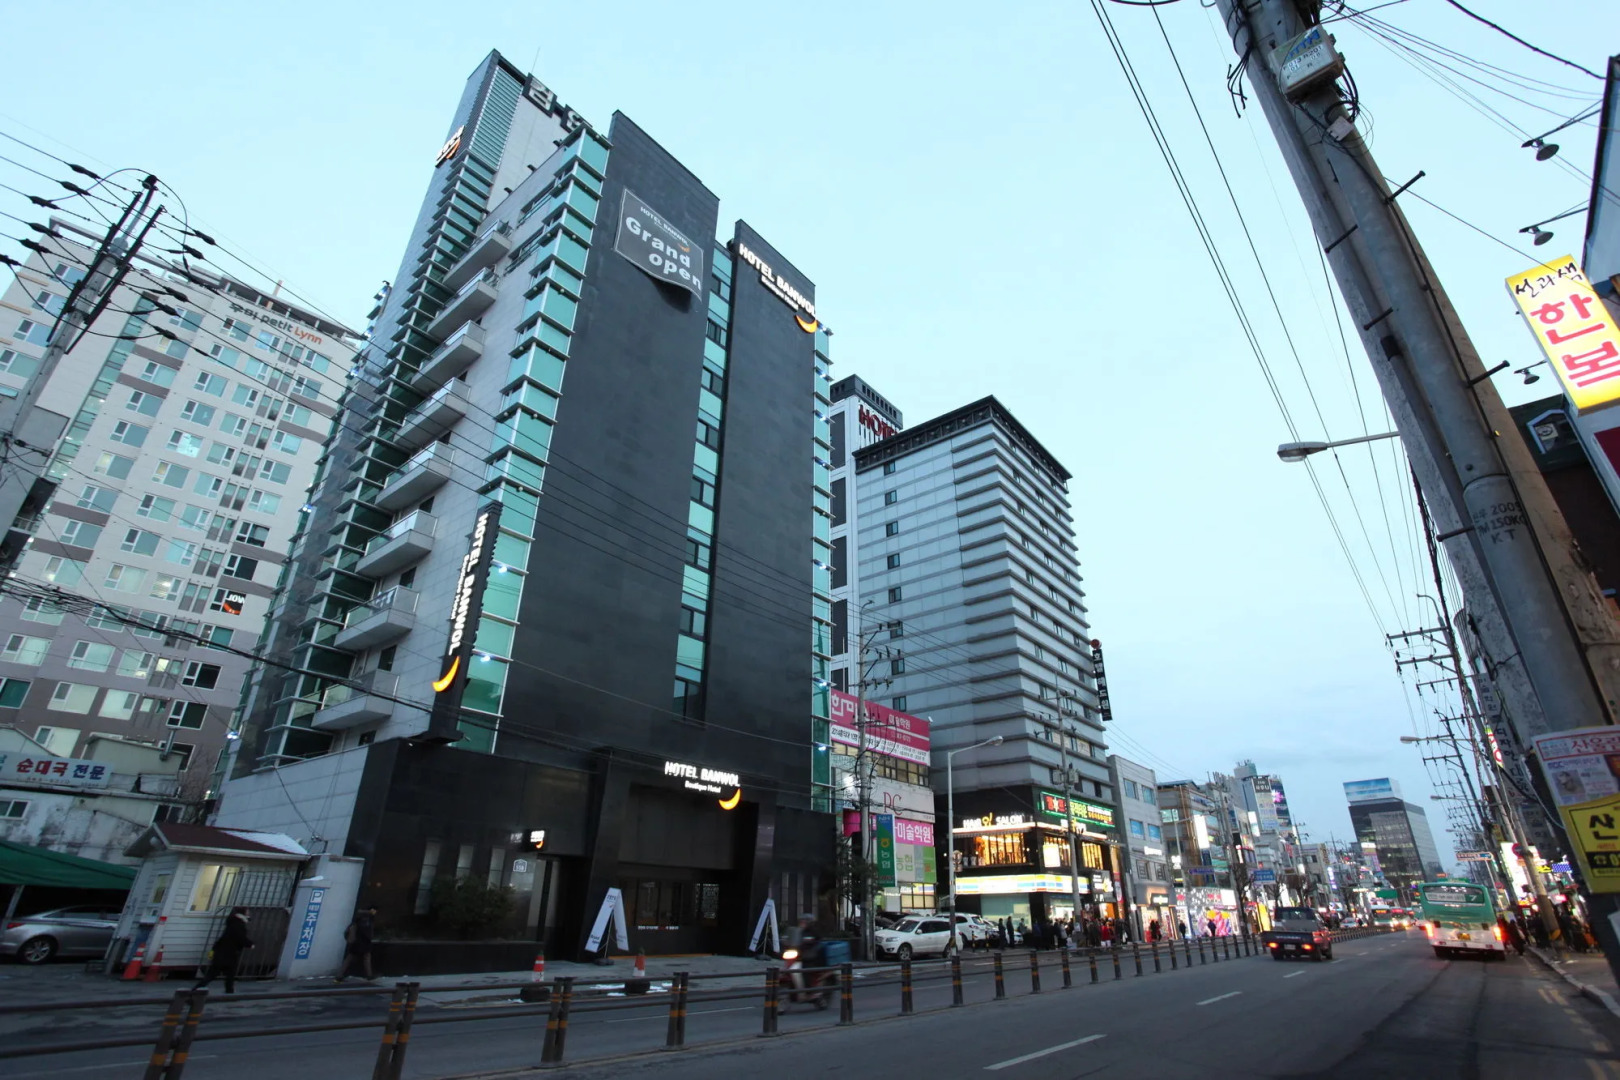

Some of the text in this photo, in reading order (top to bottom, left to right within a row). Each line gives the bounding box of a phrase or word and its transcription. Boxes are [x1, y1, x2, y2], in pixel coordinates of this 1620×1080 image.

[640, 206, 664, 225] HOTEL
[626, 217, 691, 268] Grand
[649, 253, 702, 290] open
[739, 243, 816, 317] HOTEL BANWOL
[260, 314, 294, 333] petit
[293, 326, 323, 345] Lynn
[448, 513, 488, 656] HOTEL BANWOL
[16, 758, 70, 777] 순대국
[73, 764, 106, 780] 전문
[664, 760, 741, 788] HOTEL BANWOL
[1588, 812, 1619, 841] 산
[298, 912, 317, 956] 주차장
